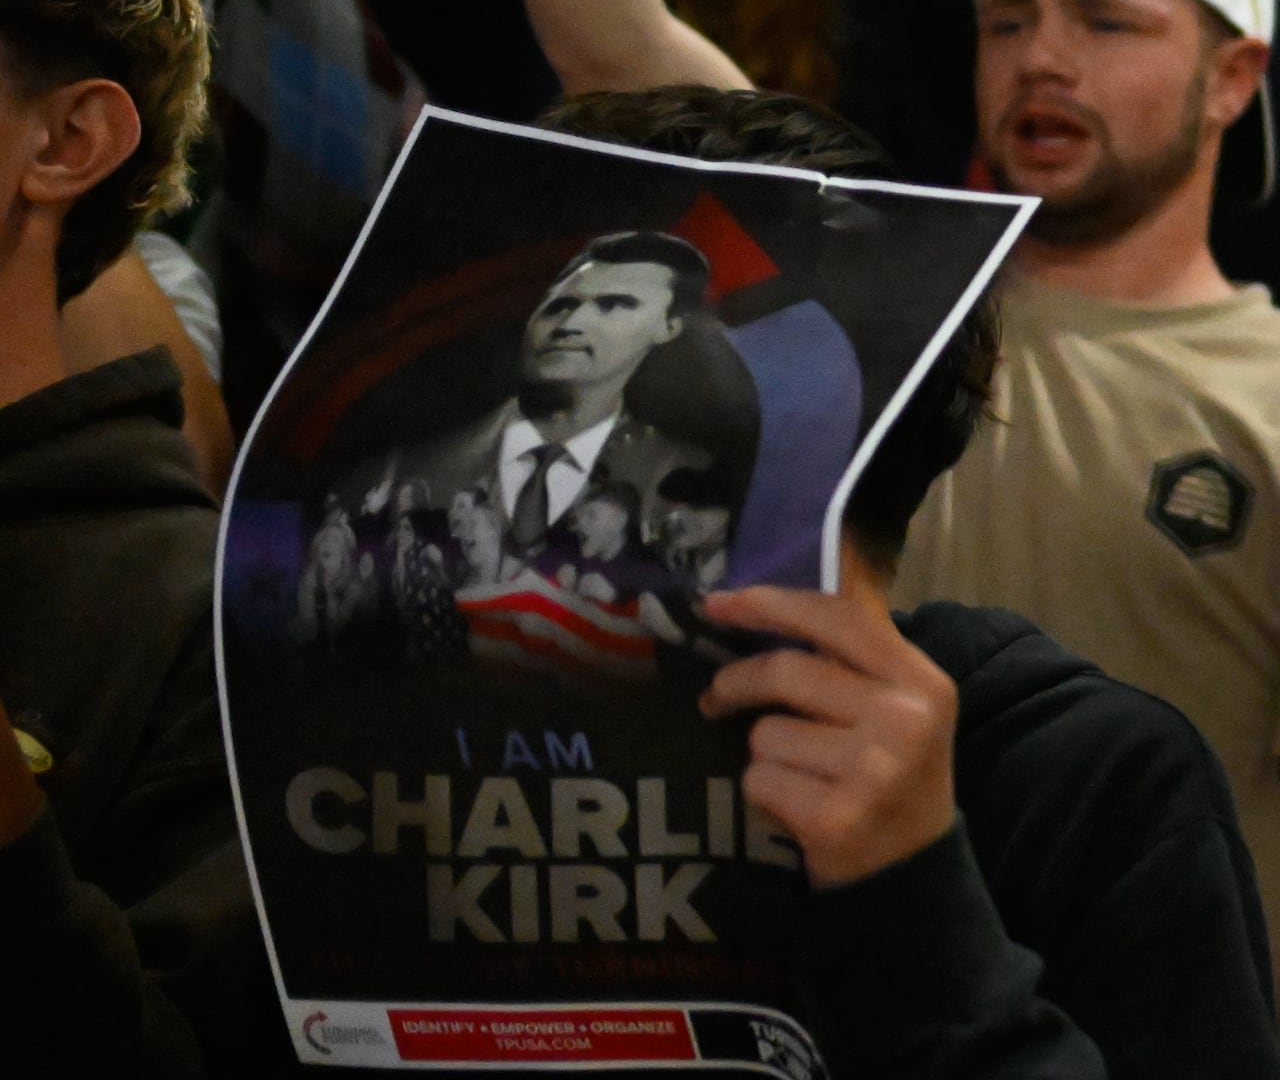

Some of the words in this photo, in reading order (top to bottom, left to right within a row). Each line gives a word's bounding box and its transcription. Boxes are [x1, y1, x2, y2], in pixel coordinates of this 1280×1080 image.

[455, 729, 471, 768] I
[502, 730, 594, 771] AM
[425, 862, 719, 945] KIRK
[402, 1021, 475, 1034] IDENTIFY
[492, 1022, 574, 1035] EMPOWER
